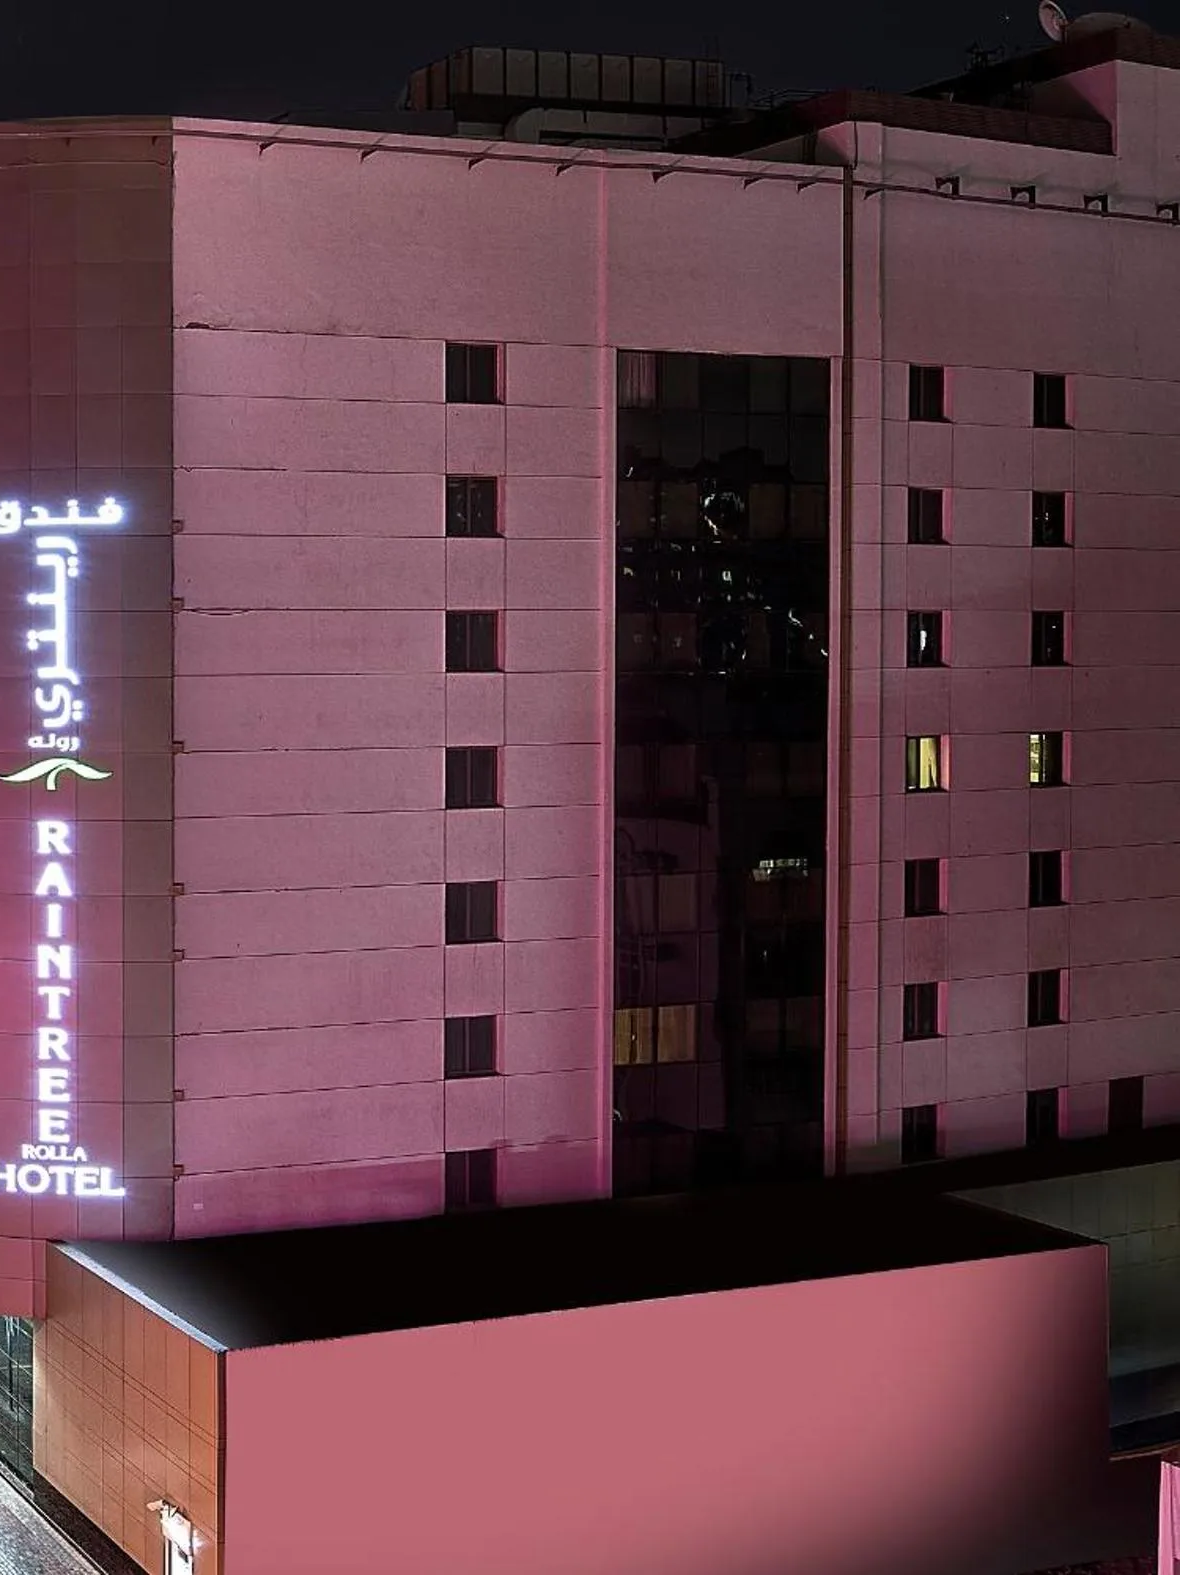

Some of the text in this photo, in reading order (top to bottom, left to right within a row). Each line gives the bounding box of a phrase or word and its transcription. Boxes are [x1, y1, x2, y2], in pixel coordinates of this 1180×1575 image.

[27, 536, 82, 728] رينتري
[34, 819, 73, 1144] RAINTREE
[22, 1144, 87, 1162] ROLLA
